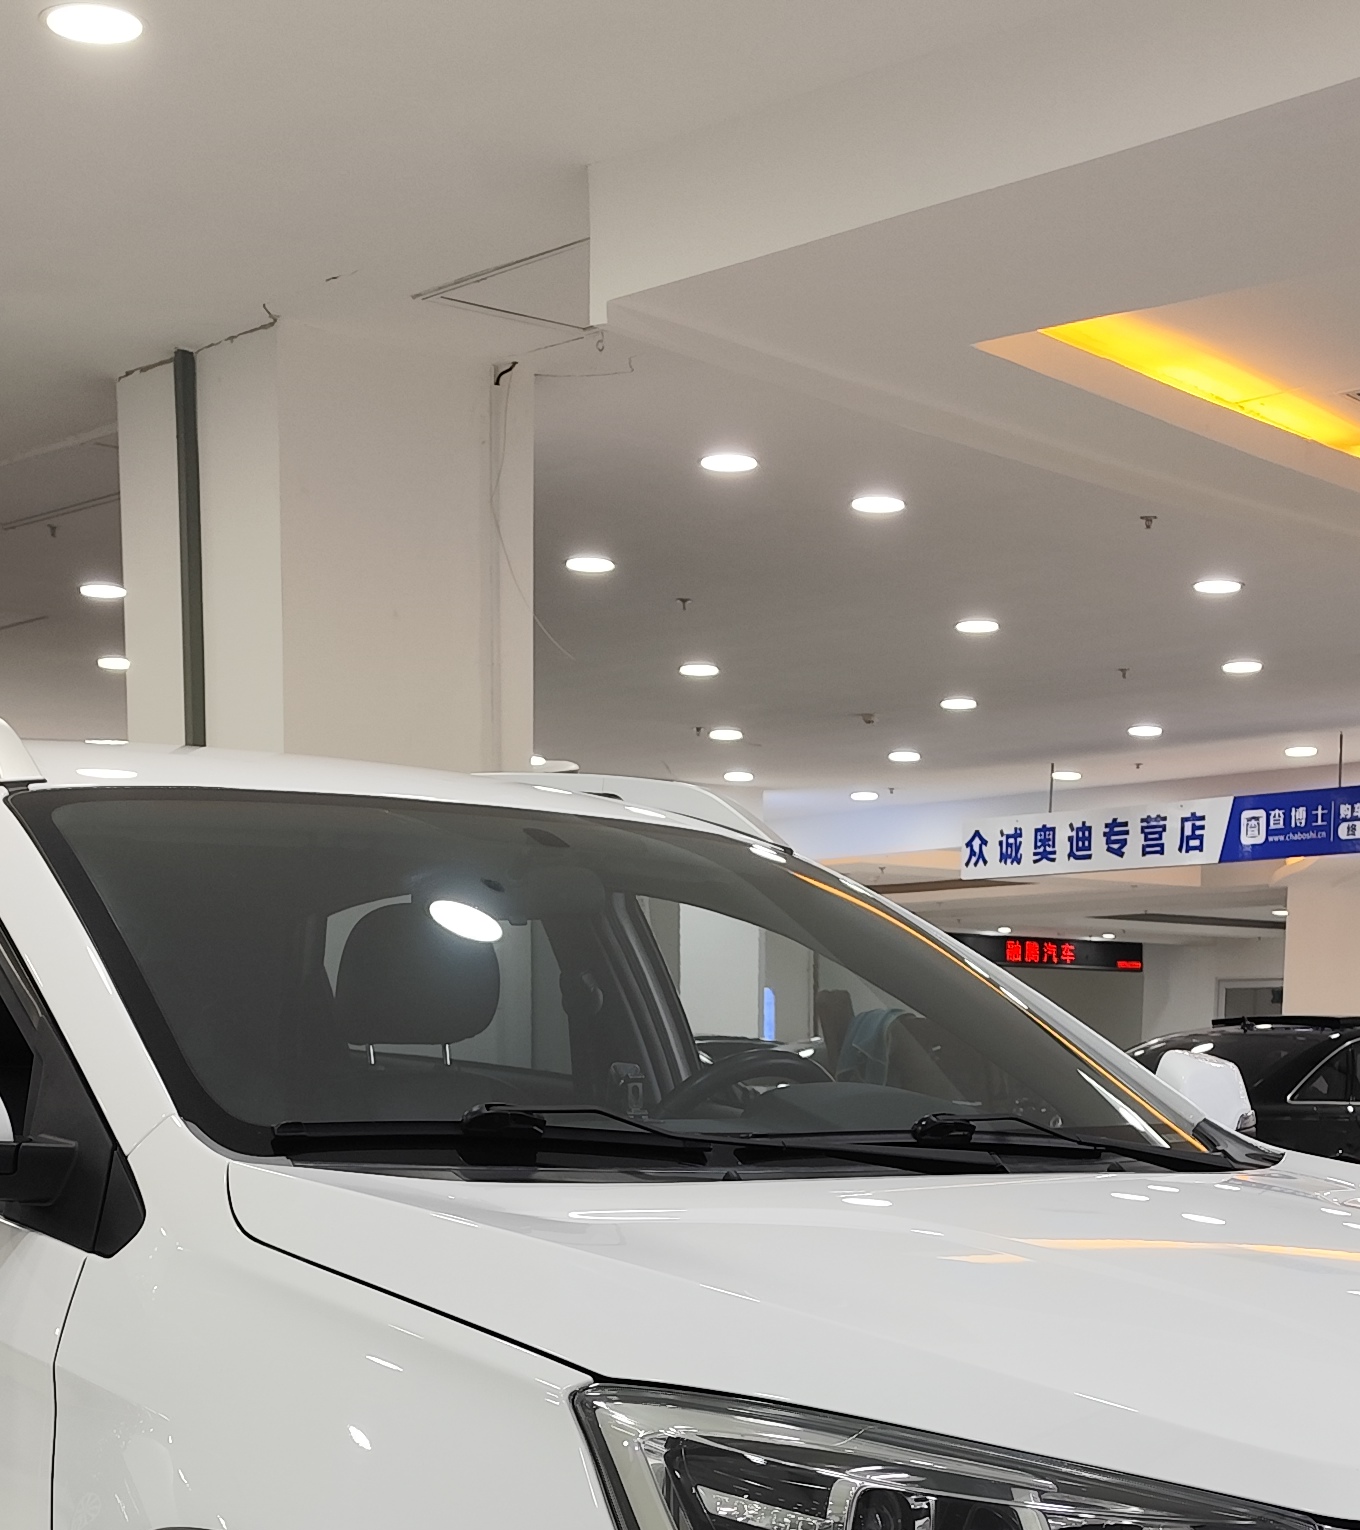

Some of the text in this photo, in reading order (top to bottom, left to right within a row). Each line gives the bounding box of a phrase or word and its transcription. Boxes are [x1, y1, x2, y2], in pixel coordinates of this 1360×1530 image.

[963, 810, 1206, 869] 众诚奥迪专营店
[1268, 805, 1328, 830] 查博士
